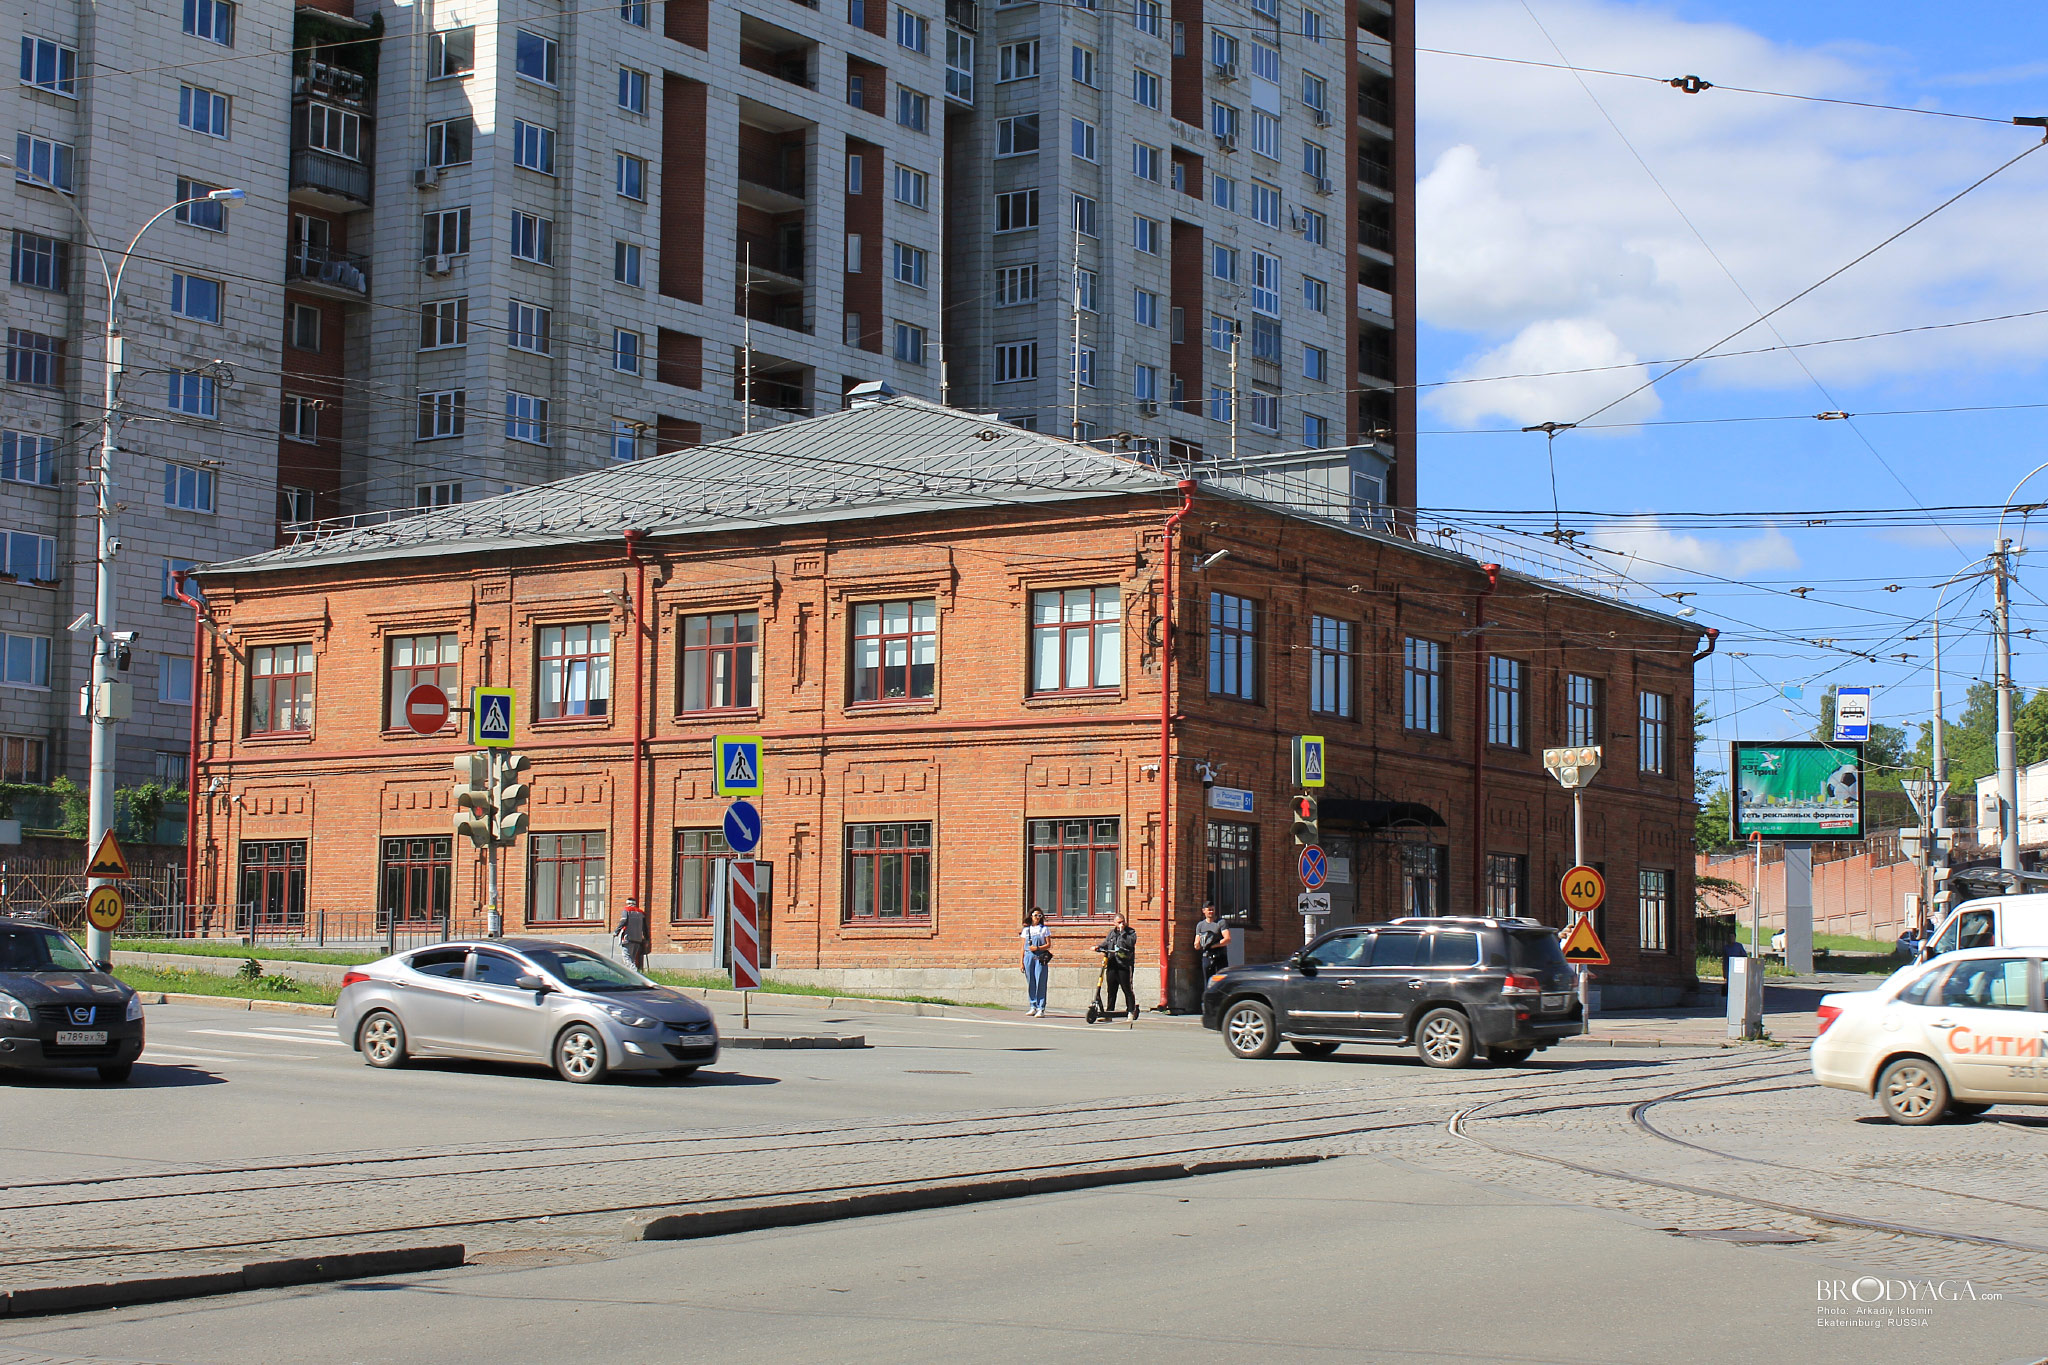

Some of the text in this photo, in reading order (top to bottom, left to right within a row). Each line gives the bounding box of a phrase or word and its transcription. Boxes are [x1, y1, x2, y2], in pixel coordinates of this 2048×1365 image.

[1812, 811, 1855, 819] форматов
[1571, 880, 1596, 898] 40
[94, 898, 118, 917] 40
